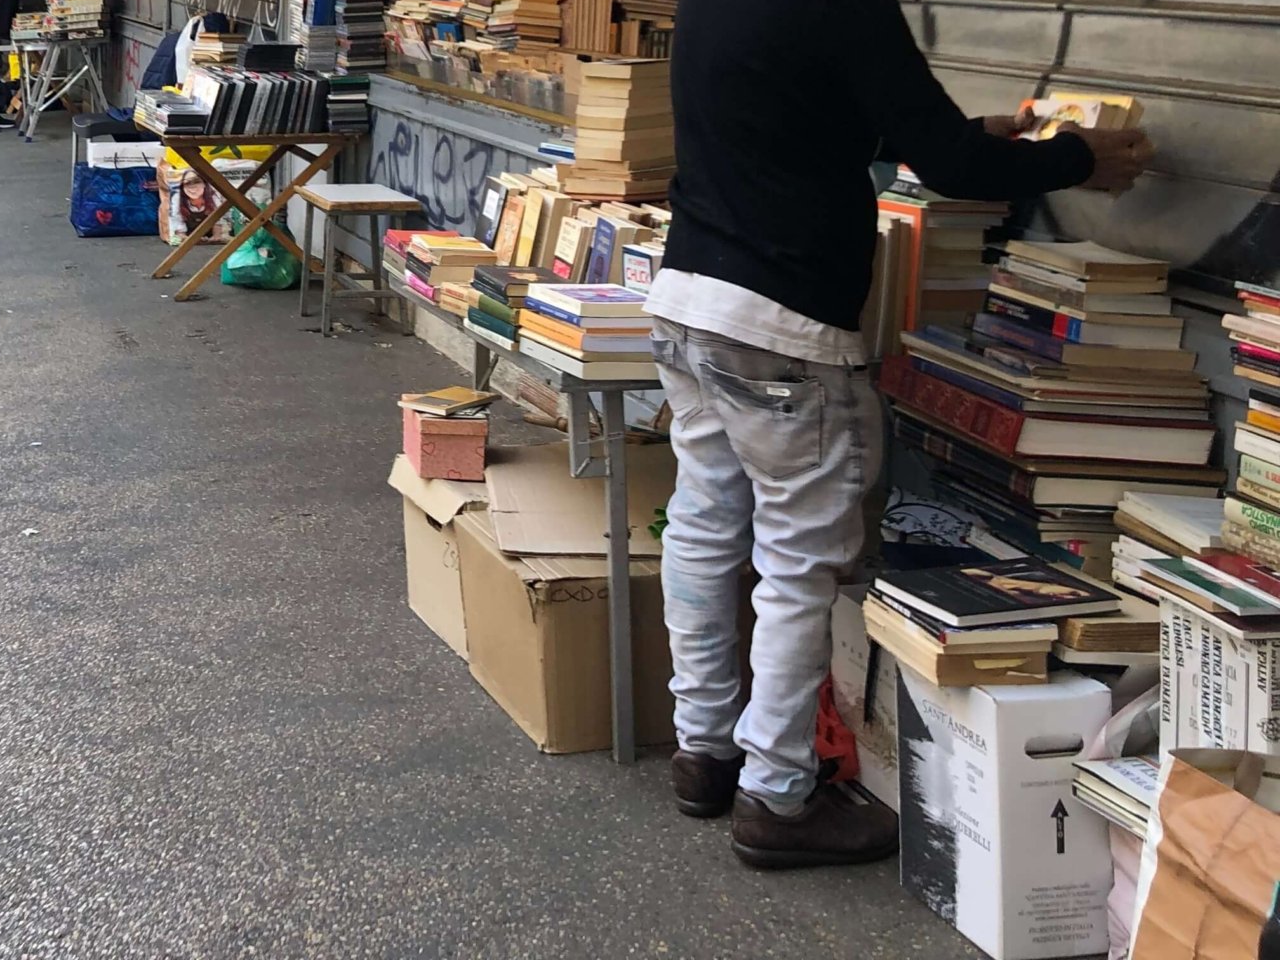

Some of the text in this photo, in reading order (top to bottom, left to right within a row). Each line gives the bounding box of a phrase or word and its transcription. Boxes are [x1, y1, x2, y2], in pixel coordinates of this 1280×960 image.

[1161, 621, 1171, 723] ANTICA FARMACIA
[1213, 635, 1222, 677] ANTICA
